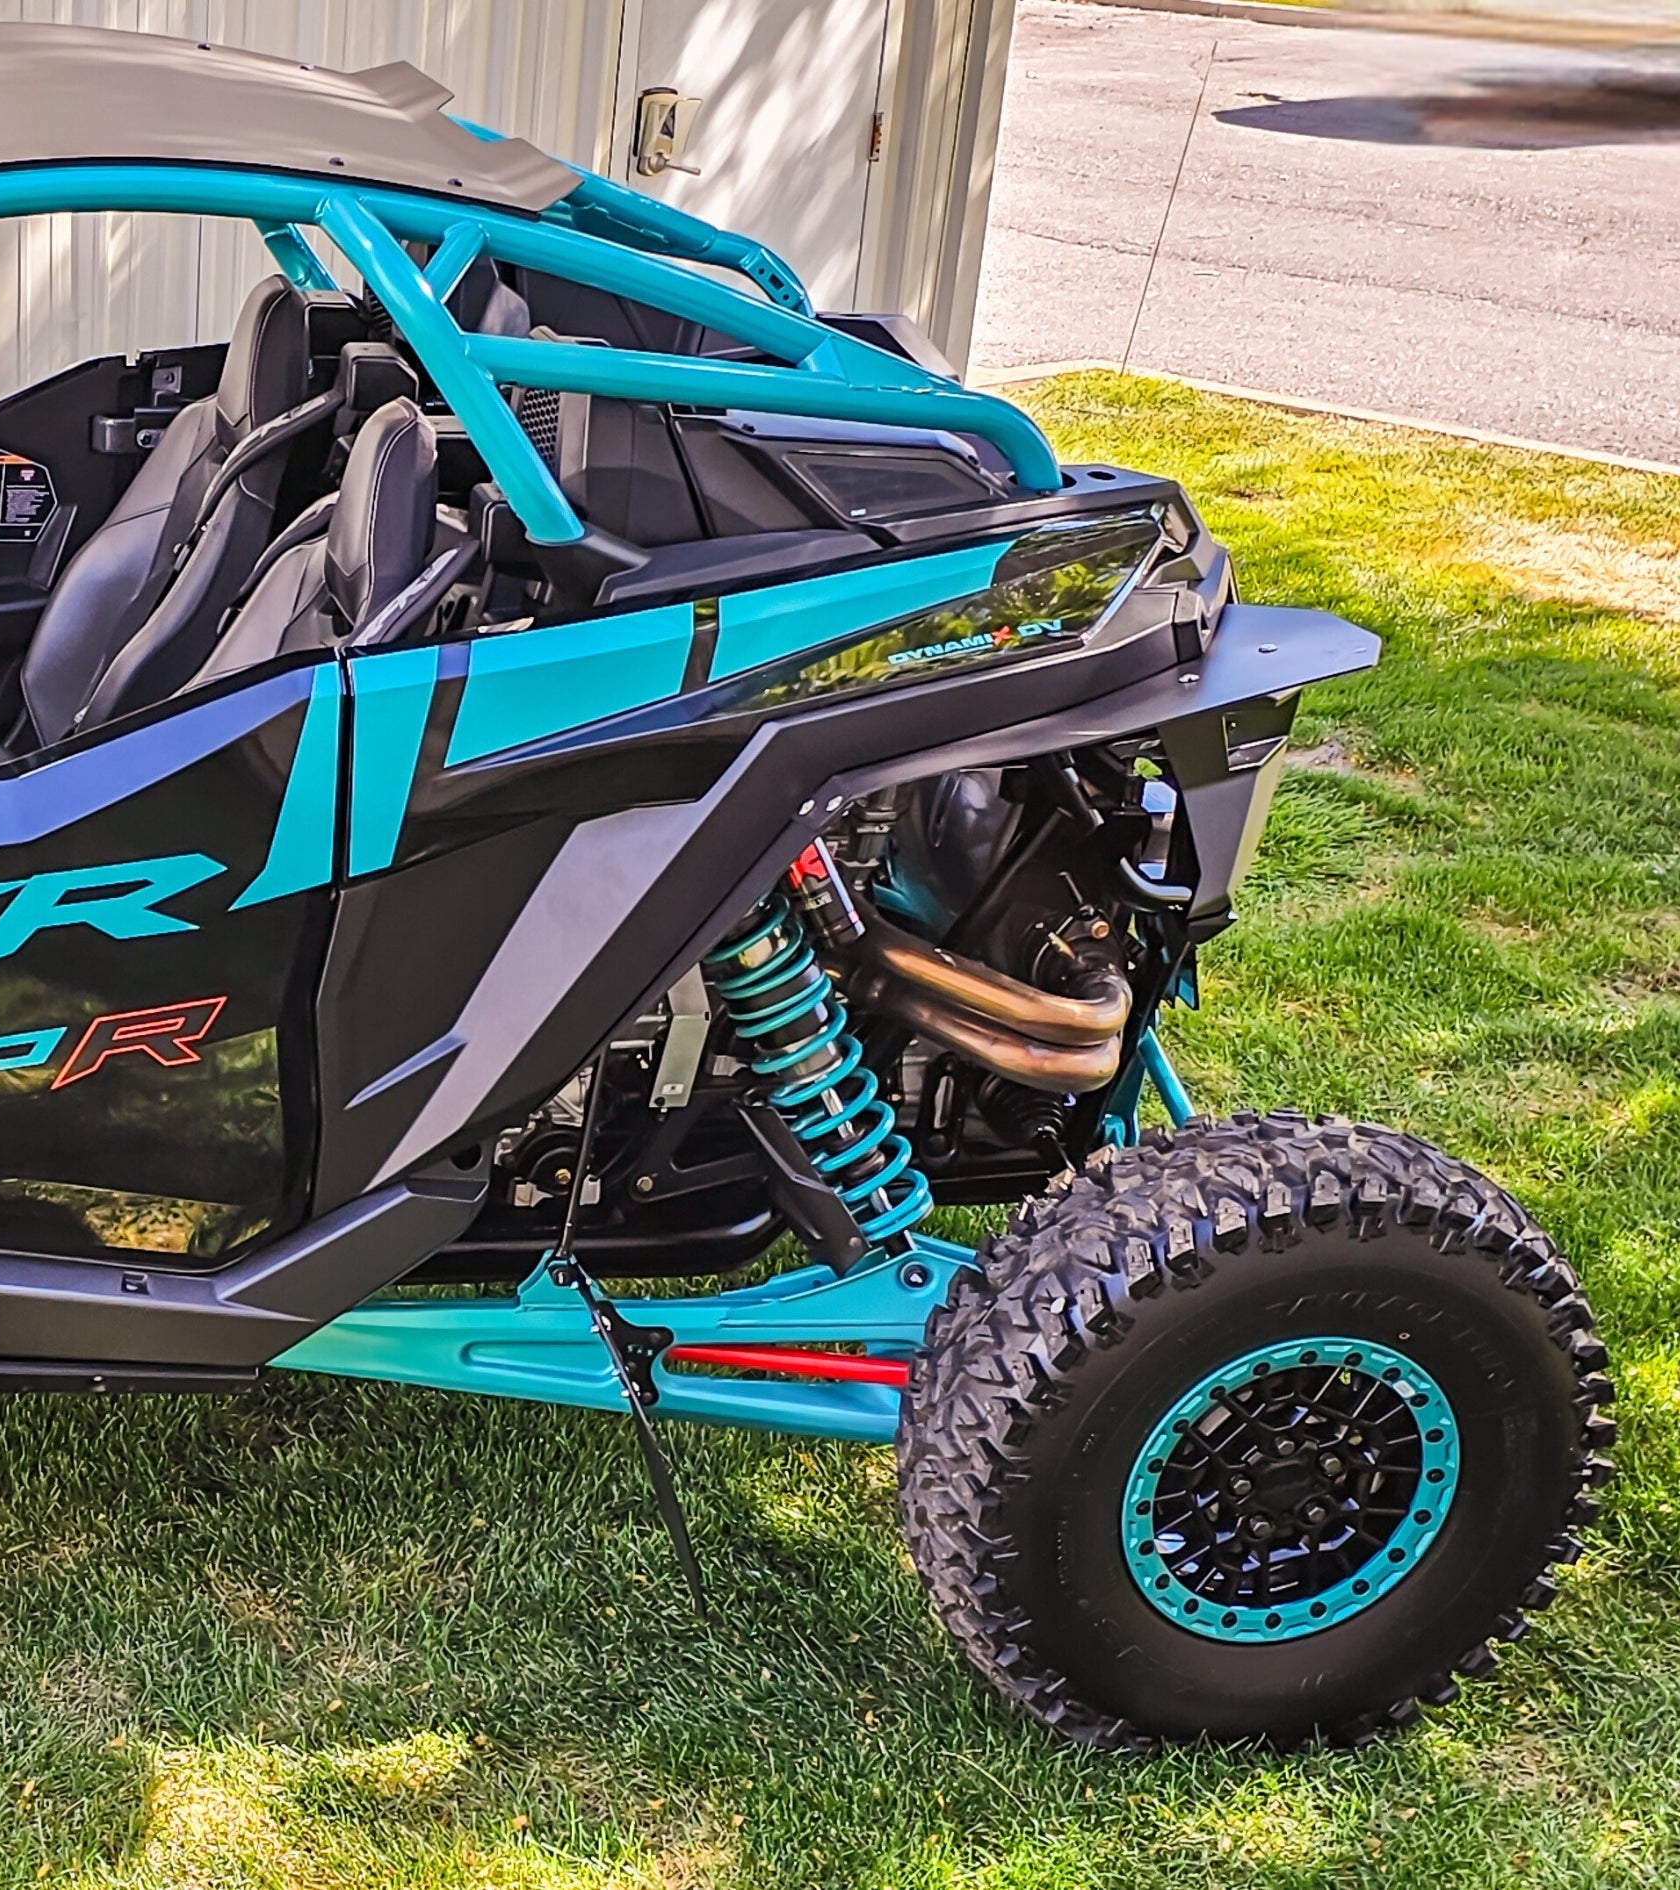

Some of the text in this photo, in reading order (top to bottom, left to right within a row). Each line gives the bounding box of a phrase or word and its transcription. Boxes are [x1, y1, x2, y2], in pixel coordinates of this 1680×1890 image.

[887, 619, 1062, 665] DYNAMIX DV
[51, 996, 228, 1091] R
